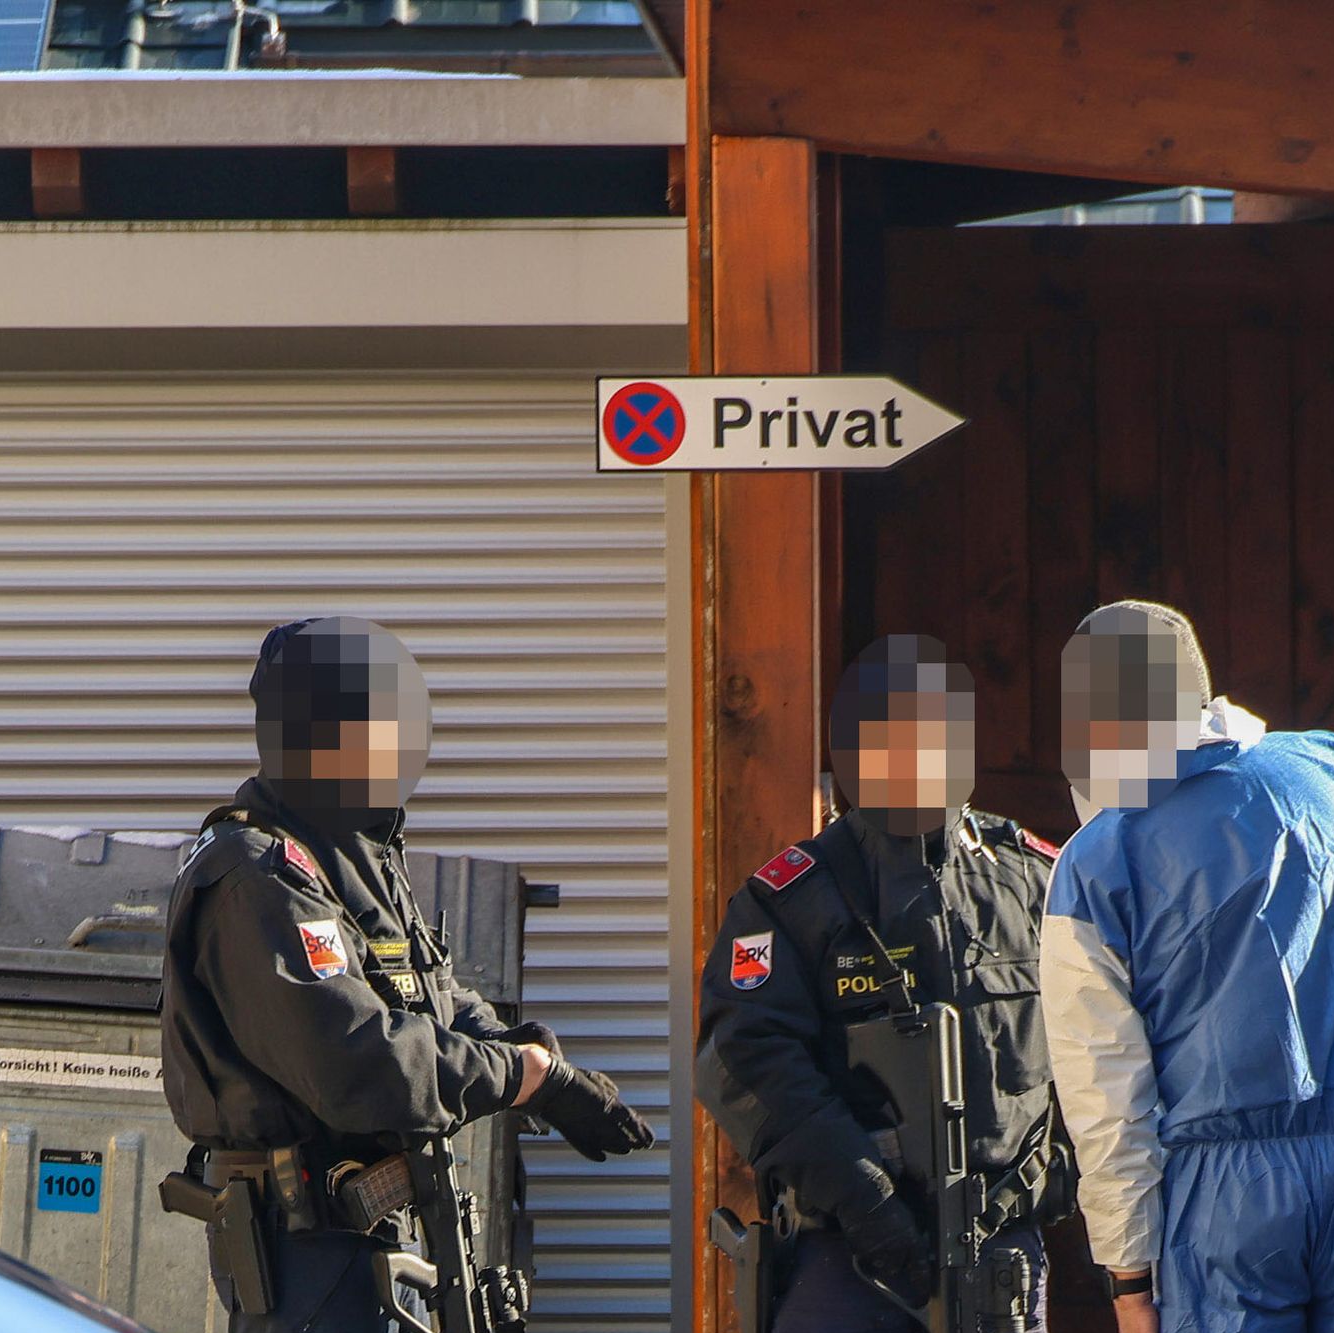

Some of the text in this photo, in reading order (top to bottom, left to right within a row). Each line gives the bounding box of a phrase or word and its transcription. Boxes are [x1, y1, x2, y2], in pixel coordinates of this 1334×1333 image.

[713, 396, 903, 450] Privat
[734, 944, 769, 966] SRK
[63, 1062, 105, 1077] Keine
[109, 1066, 151, 1079] heiße
[43, 1175, 96, 1198] 1100
